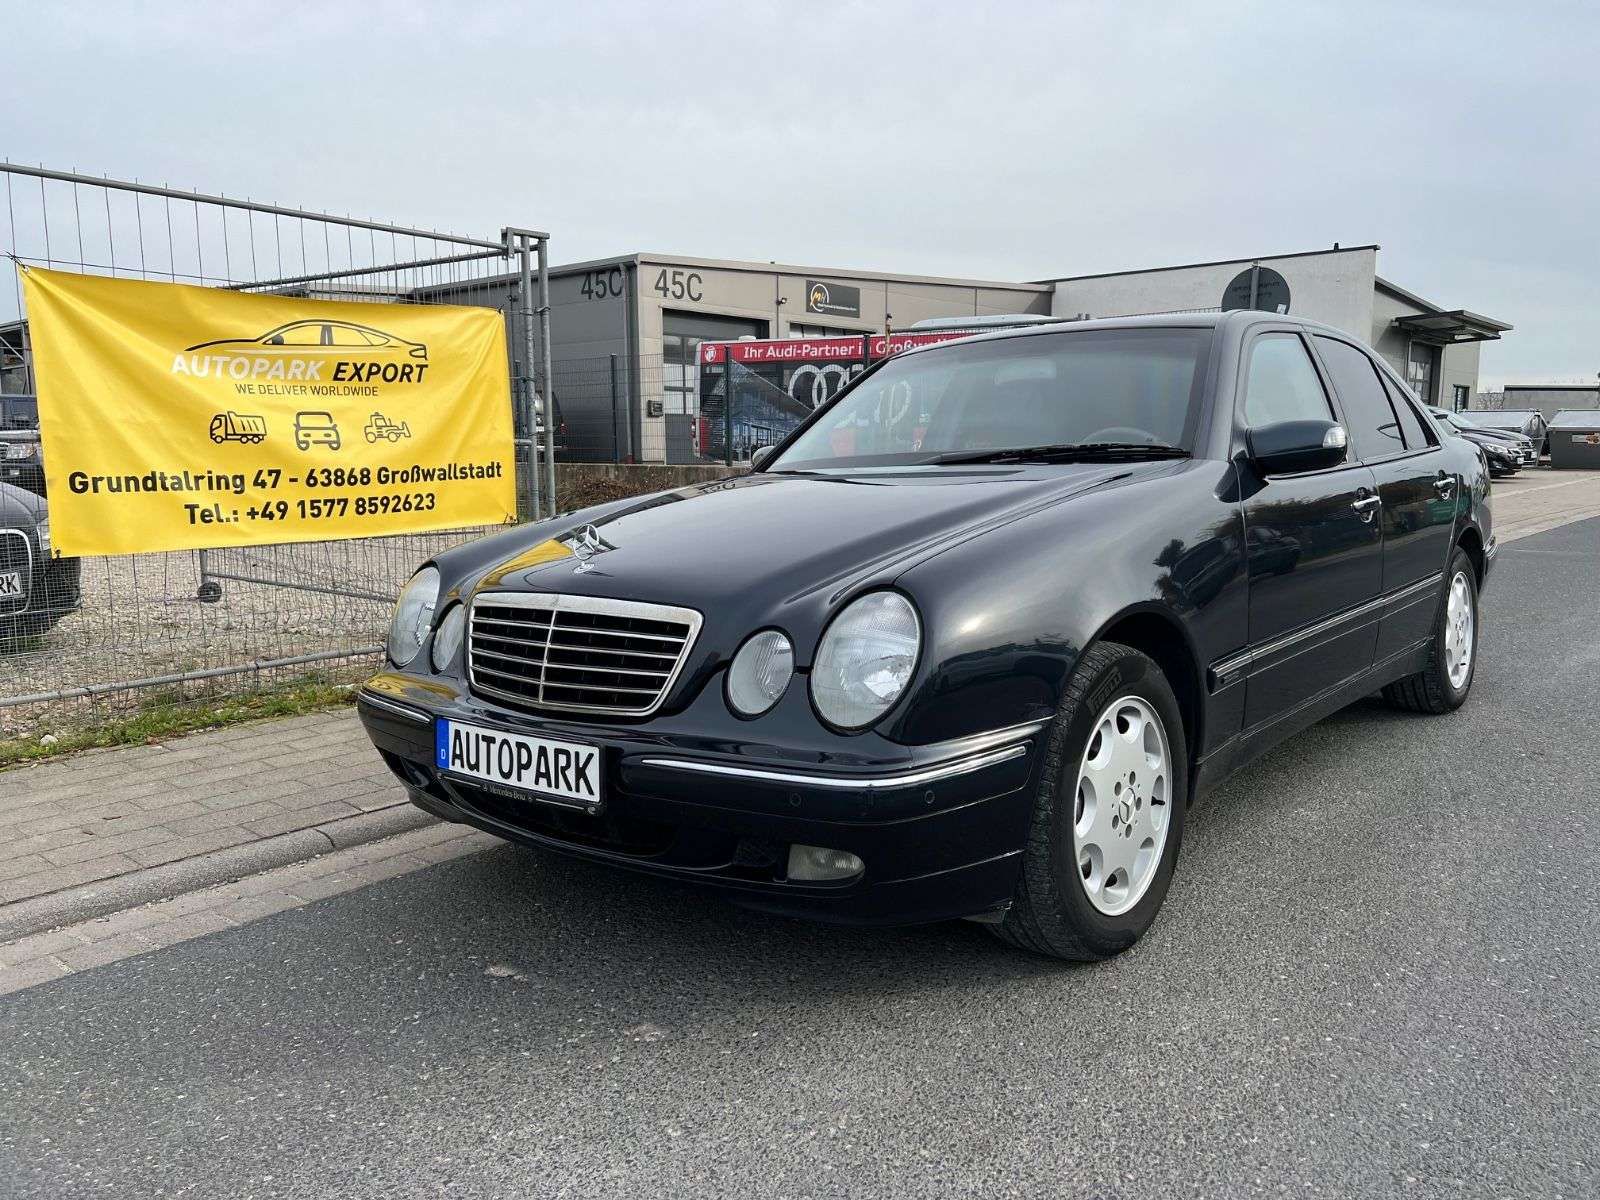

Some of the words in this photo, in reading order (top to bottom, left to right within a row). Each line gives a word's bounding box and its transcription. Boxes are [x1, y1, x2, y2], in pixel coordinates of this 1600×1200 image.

[581, 269, 624, 300] 45C
[654, 268, 703, 302] 45C
[743, 346, 764, 359] Ihr
[766, 343, 855, 358] Audi-Partner
[170, 354, 325, 382] AUTOPARK
[332, 361, 429, 383] EXPORT
[235, 383, 256, 395] WE
[258, 384, 307, 396] DELIVER
[309, 385, 379, 397] WORLDWIDE
[68, 470, 246, 494] Grundtalring
[252, 469, 282, 489] 47
[305, 468, 371, 488] 63868
[376, 461, 502, 485] Großwallstadt
[183, 503, 239, 525] Tel.:
[246, 500, 289, 521] +49
[296, 498, 349, 519] 1577
[355, 493, 436, 516] 8592623
[440, 748, 446, 760] D
[451, 728, 595, 797] AUTOPARK
